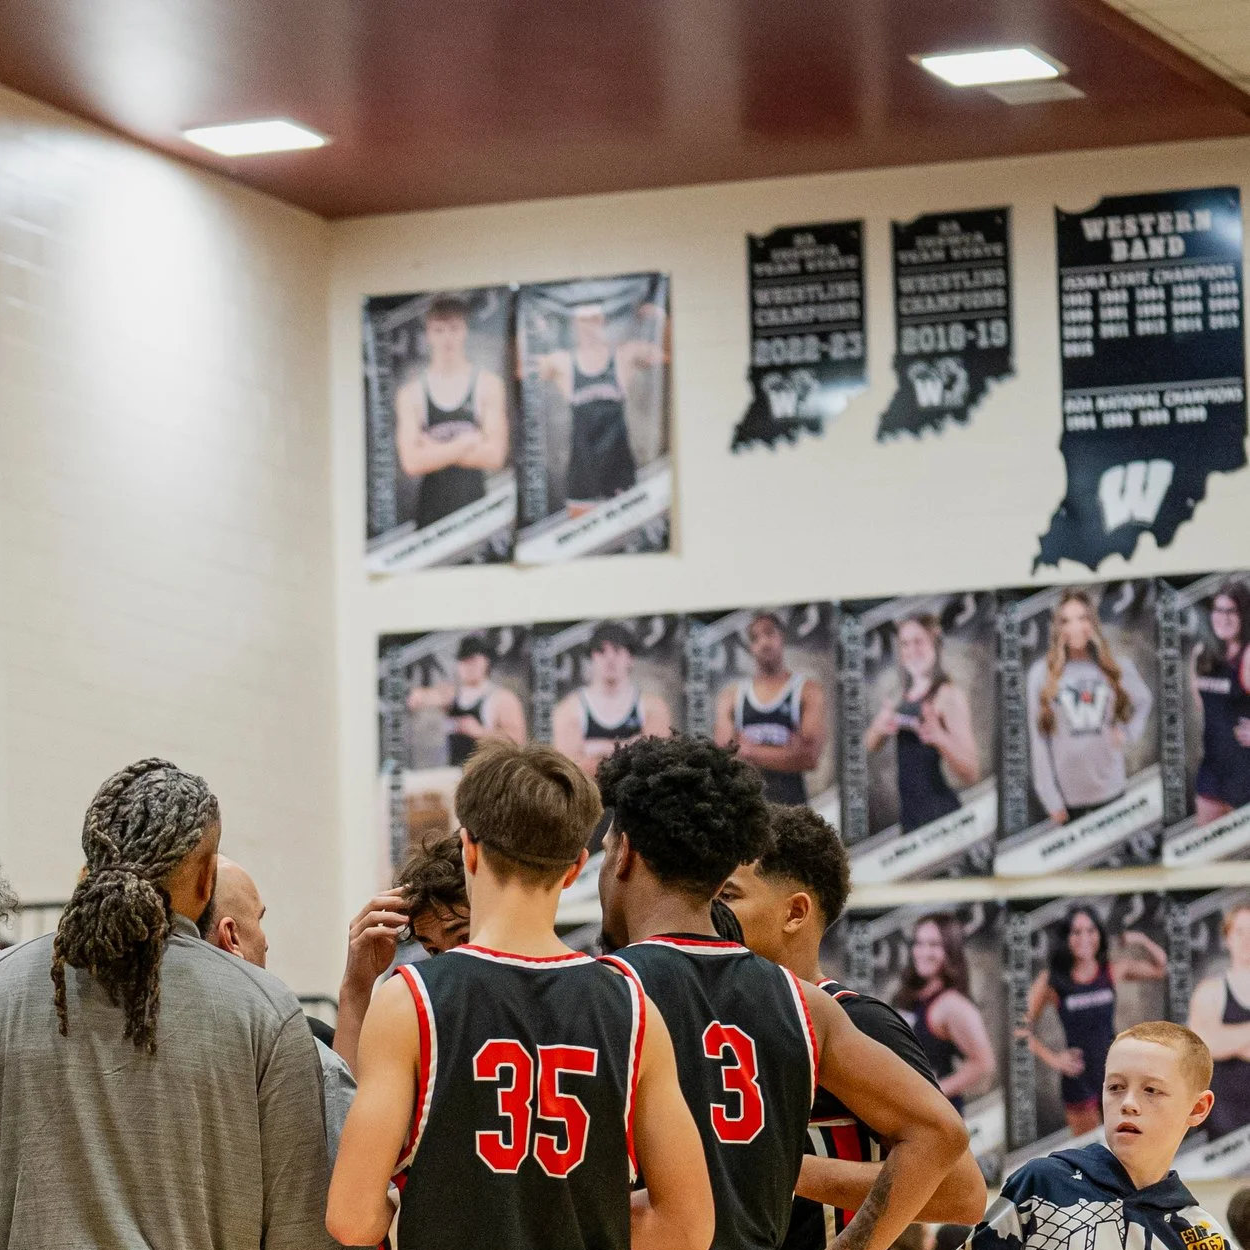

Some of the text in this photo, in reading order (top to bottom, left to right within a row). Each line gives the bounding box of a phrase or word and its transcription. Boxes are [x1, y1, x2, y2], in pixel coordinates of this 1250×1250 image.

[1080, 209, 1212, 241] WESTERN
[1110, 235, 1185, 262] BAND
[755, 280, 860, 305] WRESTLING
[899, 268, 1005, 293] WRESTLING
[755, 302, 860, 325] CHAMPIONS
[900, 288, 1005, 314] CHAMPIONS
[1100, 458, 1175, 535] W
[702, 1020, 765, 1144] 3
[472, 1038, 599, 1178] 35
